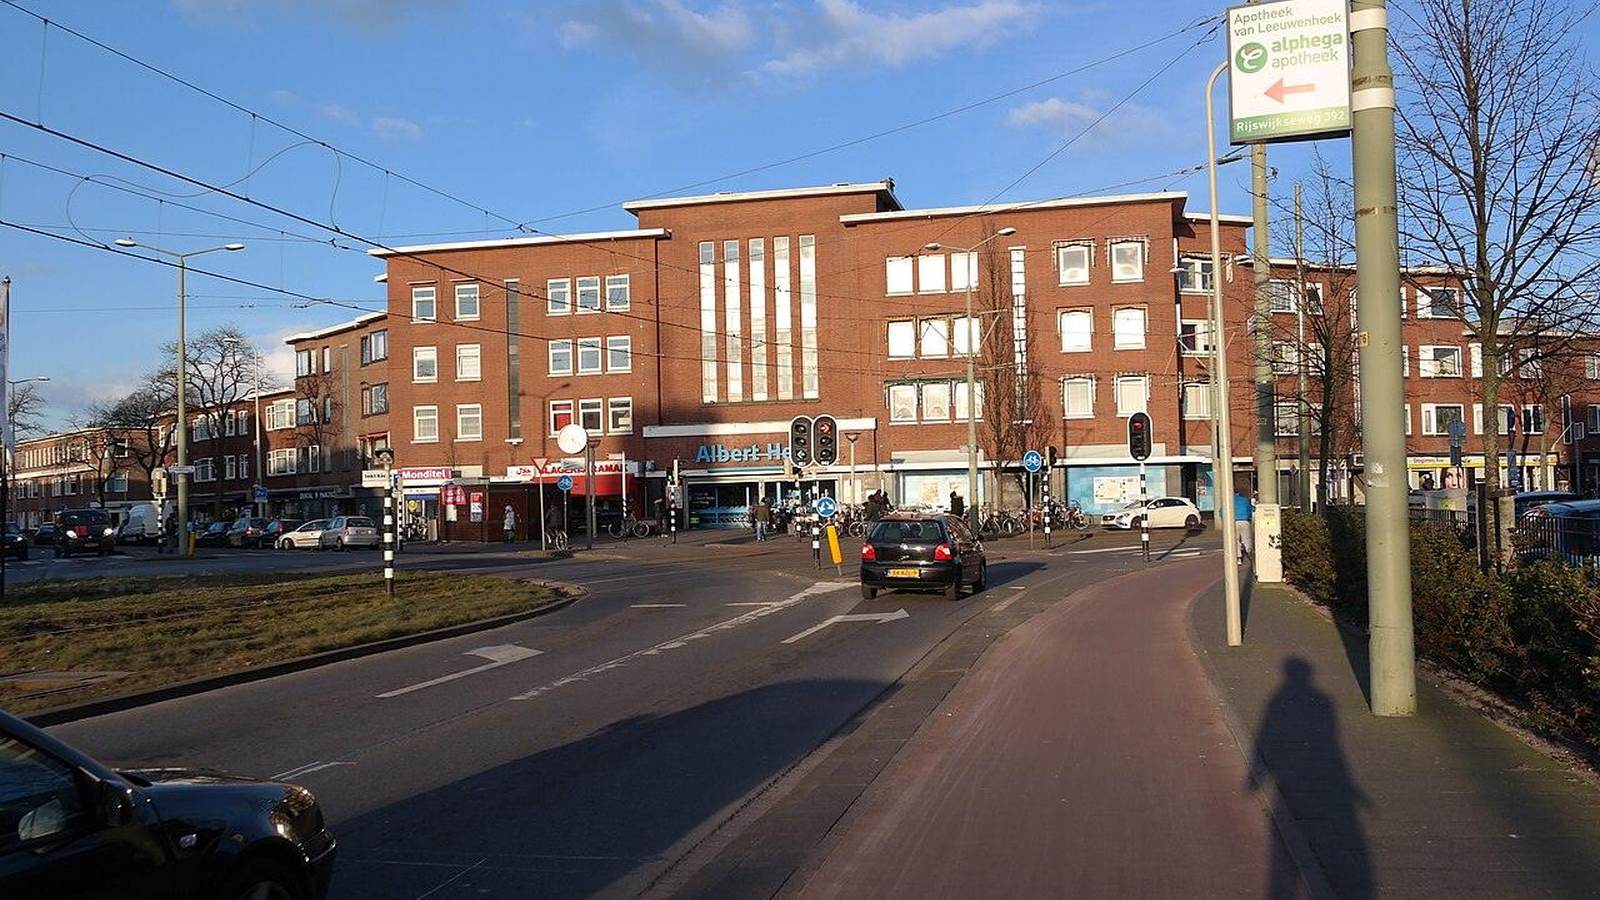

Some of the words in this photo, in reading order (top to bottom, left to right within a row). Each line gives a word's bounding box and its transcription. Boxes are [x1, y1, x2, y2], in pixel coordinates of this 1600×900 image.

[1234, 7, 1293, 25] Apotheek
[1234, 27, 1255, 37] van
[1258, 12, 1342, 33] Leeuwenhoek
[1271, 33, 1343, 53] alphega
[1271, 48, 1339, 70] apotheek
[1236, 113, 1321, 133] Rijswijkseweg
[1325, 110, 1346, 122] 392
[696, 444, 761, 463] Albert
[767, 442, 791, 460] He
[401, 469, 446, 480] Monditel
